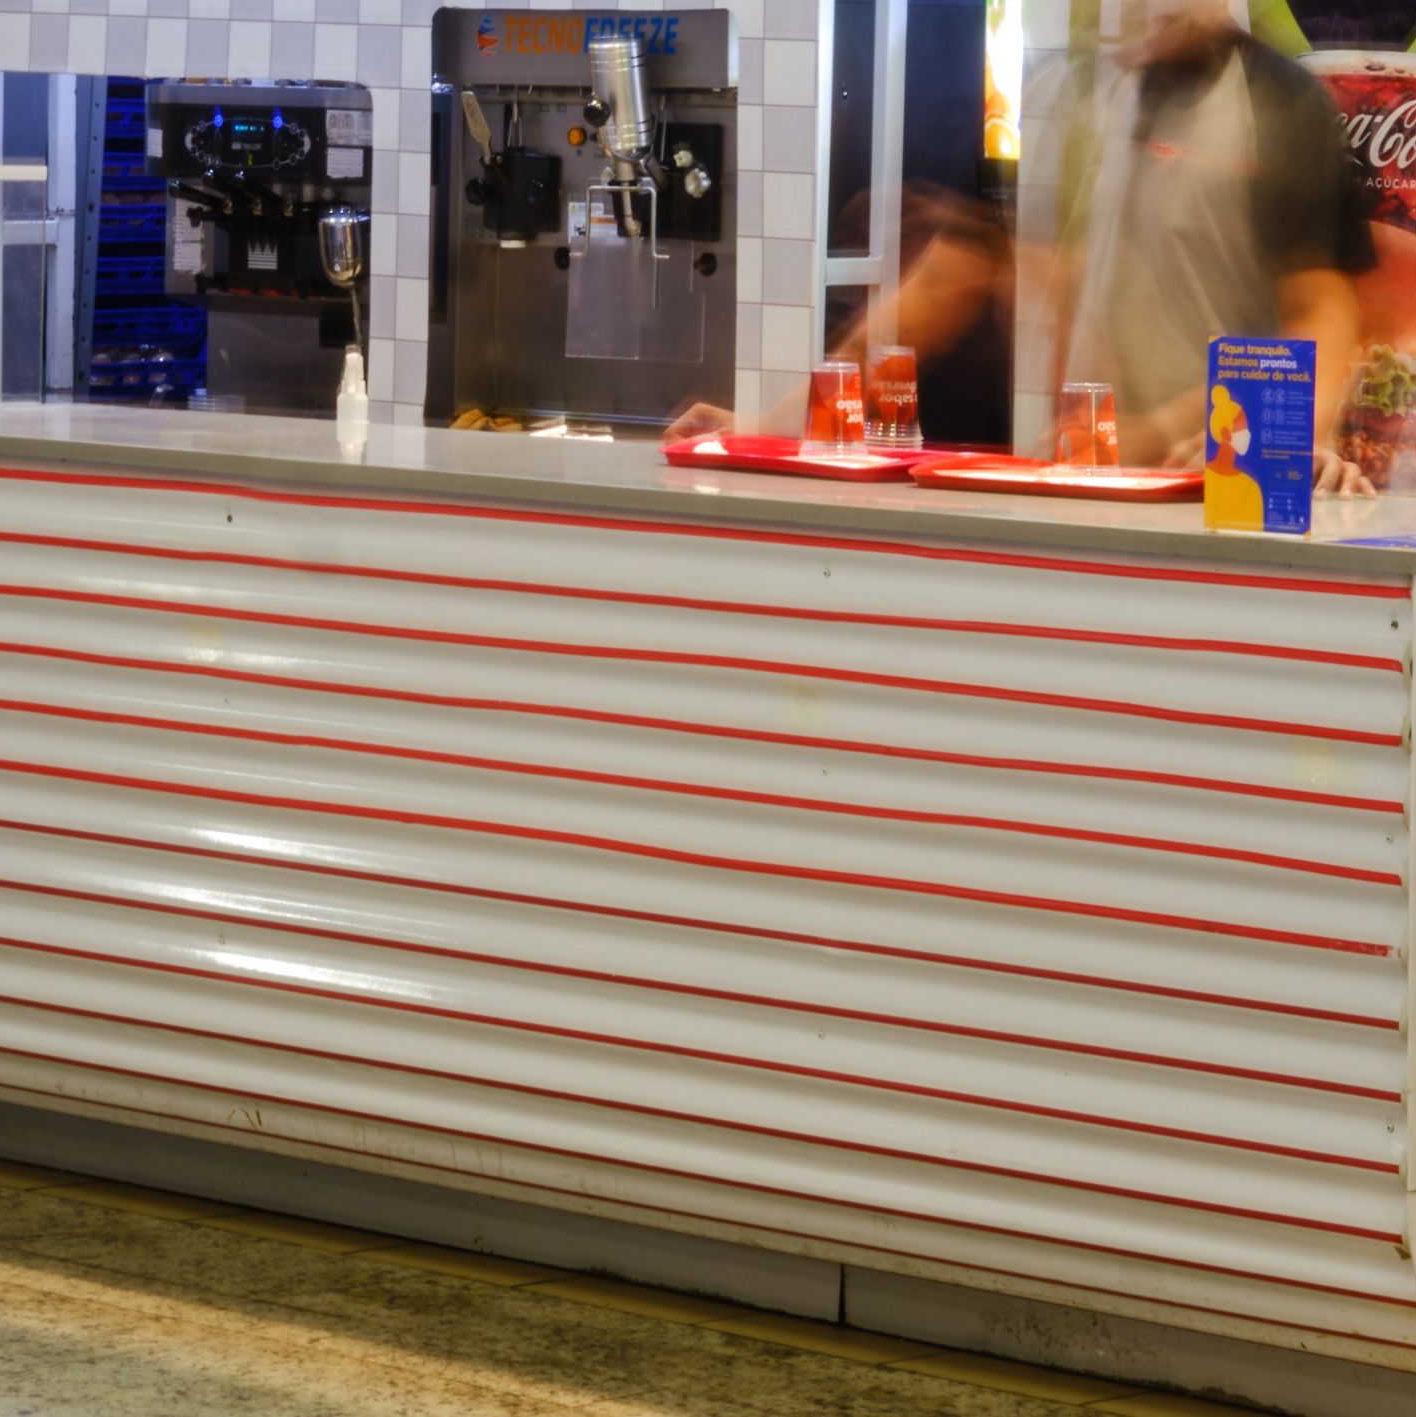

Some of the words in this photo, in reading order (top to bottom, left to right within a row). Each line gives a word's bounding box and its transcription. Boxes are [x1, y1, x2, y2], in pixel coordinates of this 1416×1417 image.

[1218, 343, 1245, 356] Fique
[1247, 344, 1292, 358] tranquilo.
[1218, 355, 1259, 368] Estamos
[1259, 357, 1297, 370] prontos
[1218, 369, 1240, 381] para
[1241, 370, 1271, 381] cuidar
[1273, 371, 1285, 381] de
